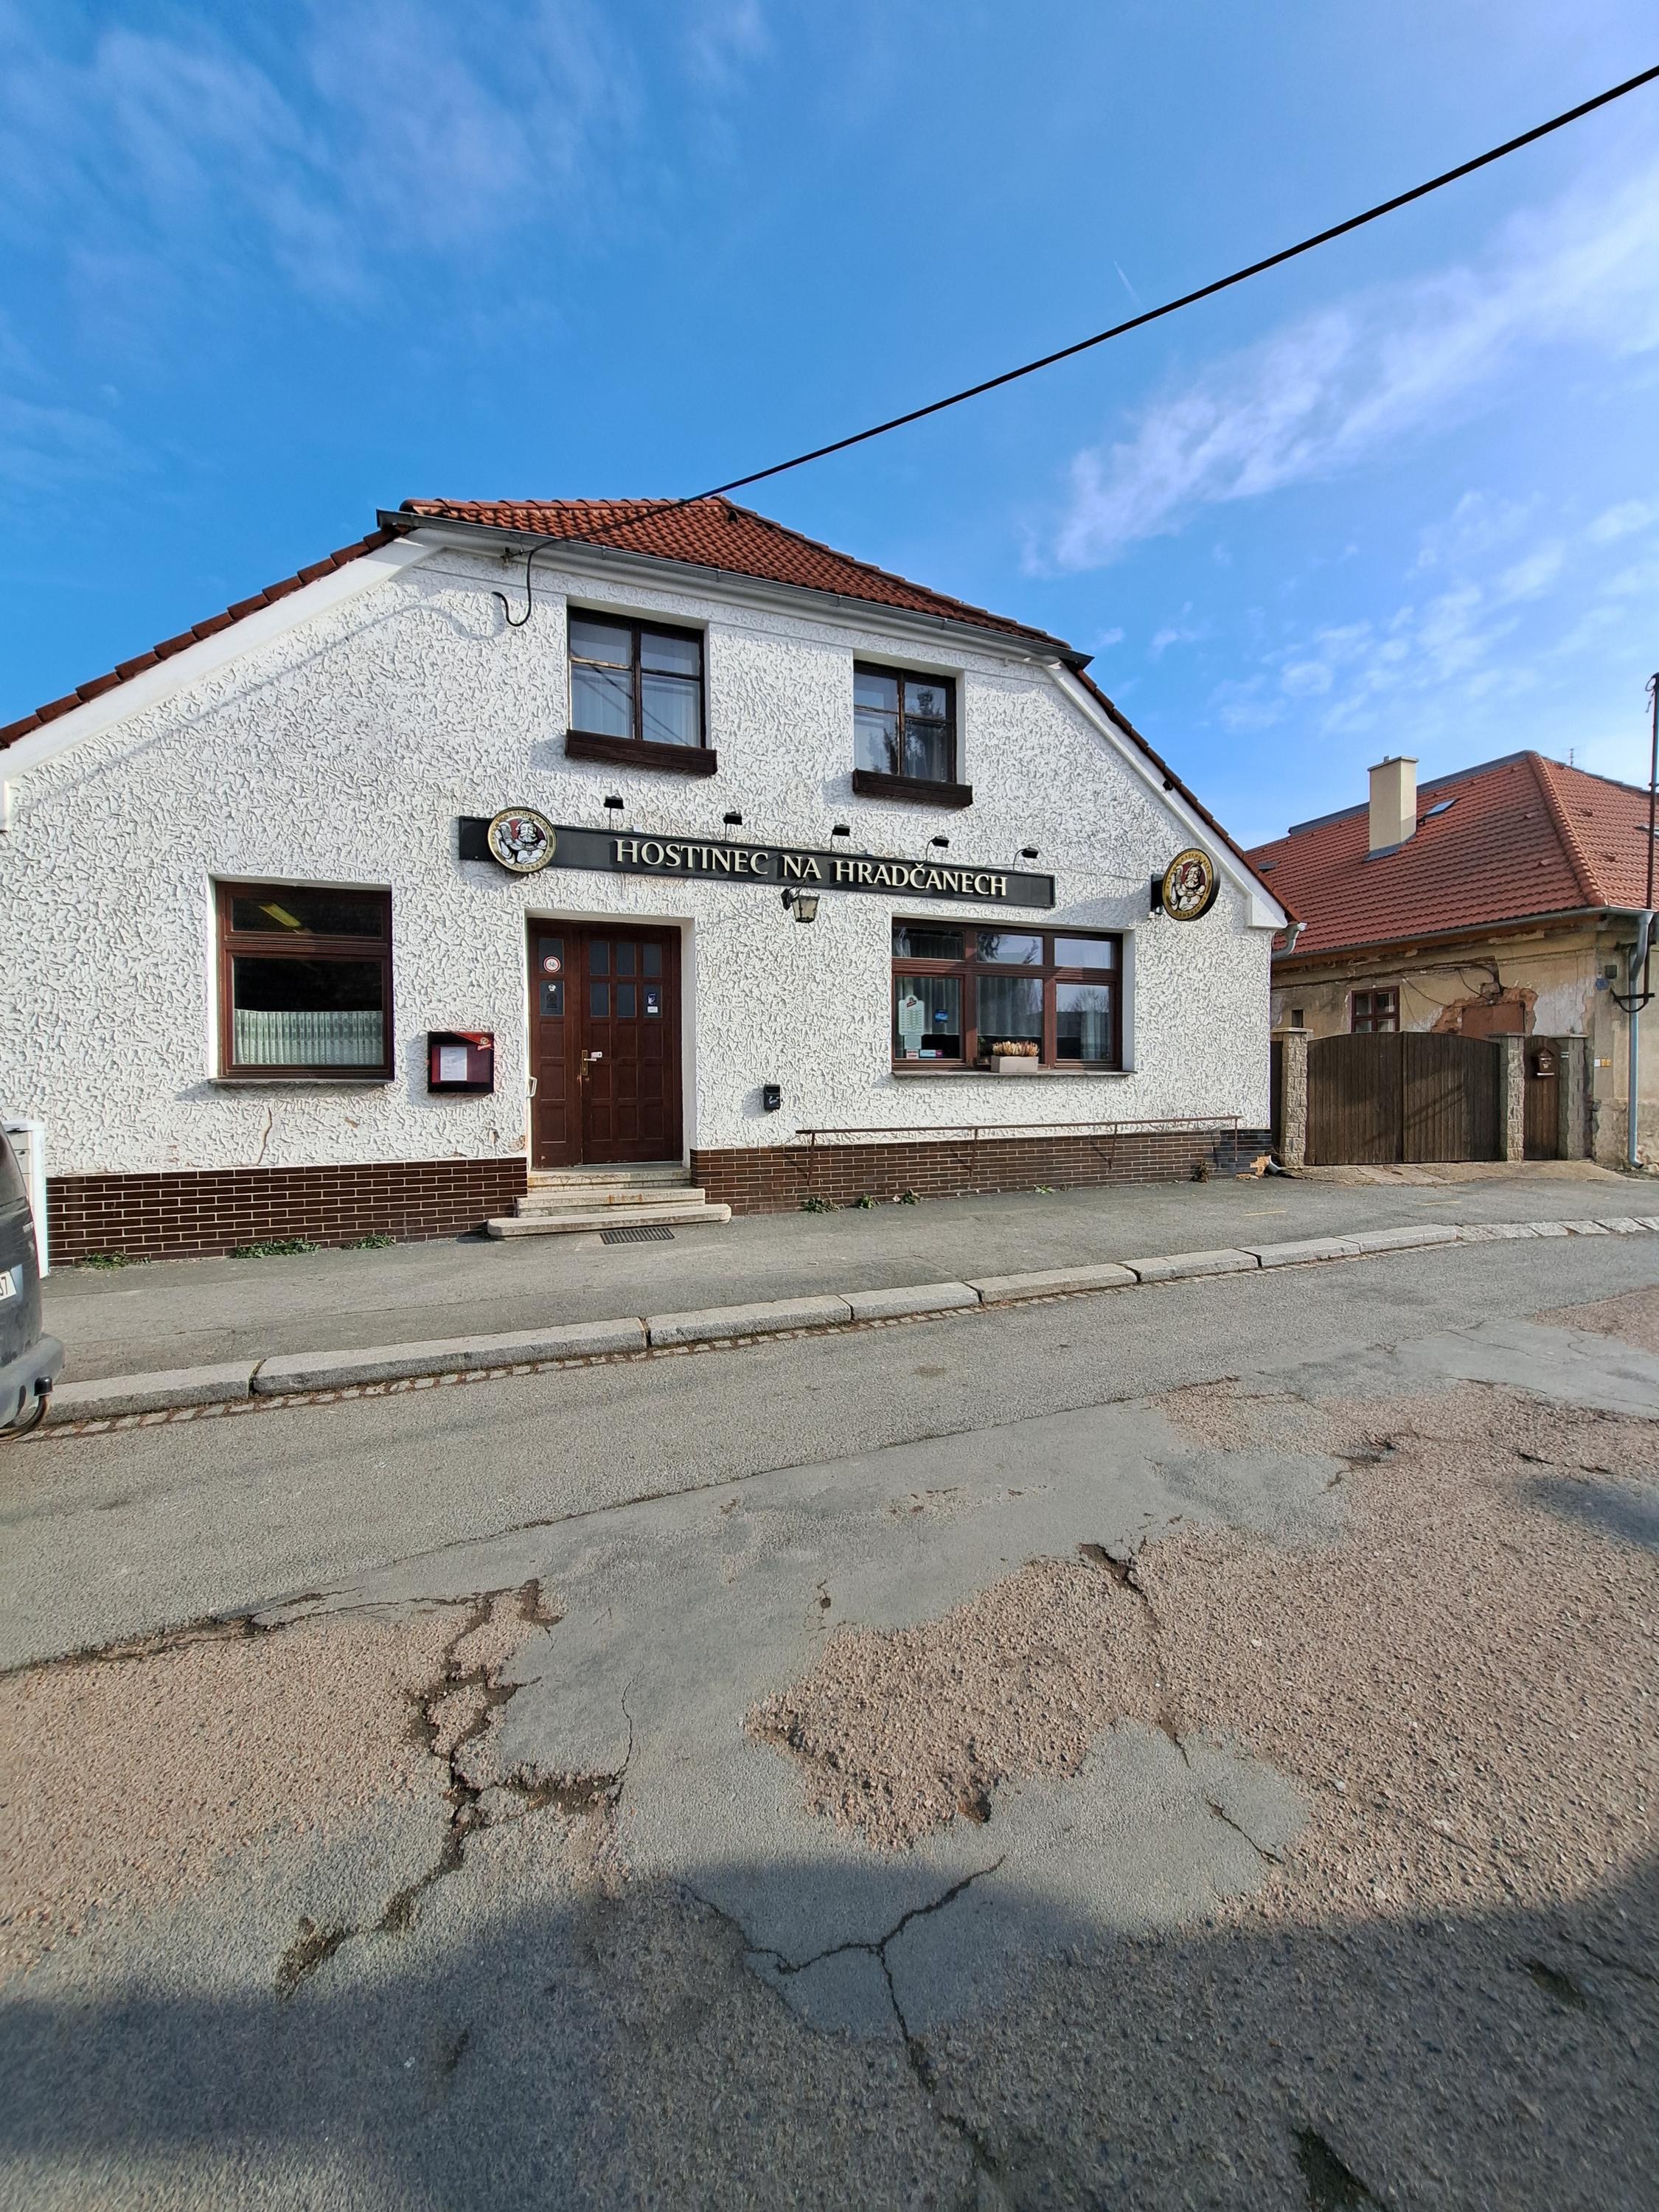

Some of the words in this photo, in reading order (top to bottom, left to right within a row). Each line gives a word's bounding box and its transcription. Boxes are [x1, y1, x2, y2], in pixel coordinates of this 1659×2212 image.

[614, 839, 768, 874] HOSTINEC
[782, 855, 821, 879] NA
[834, 860, 1008, 897] HRADČANECH
